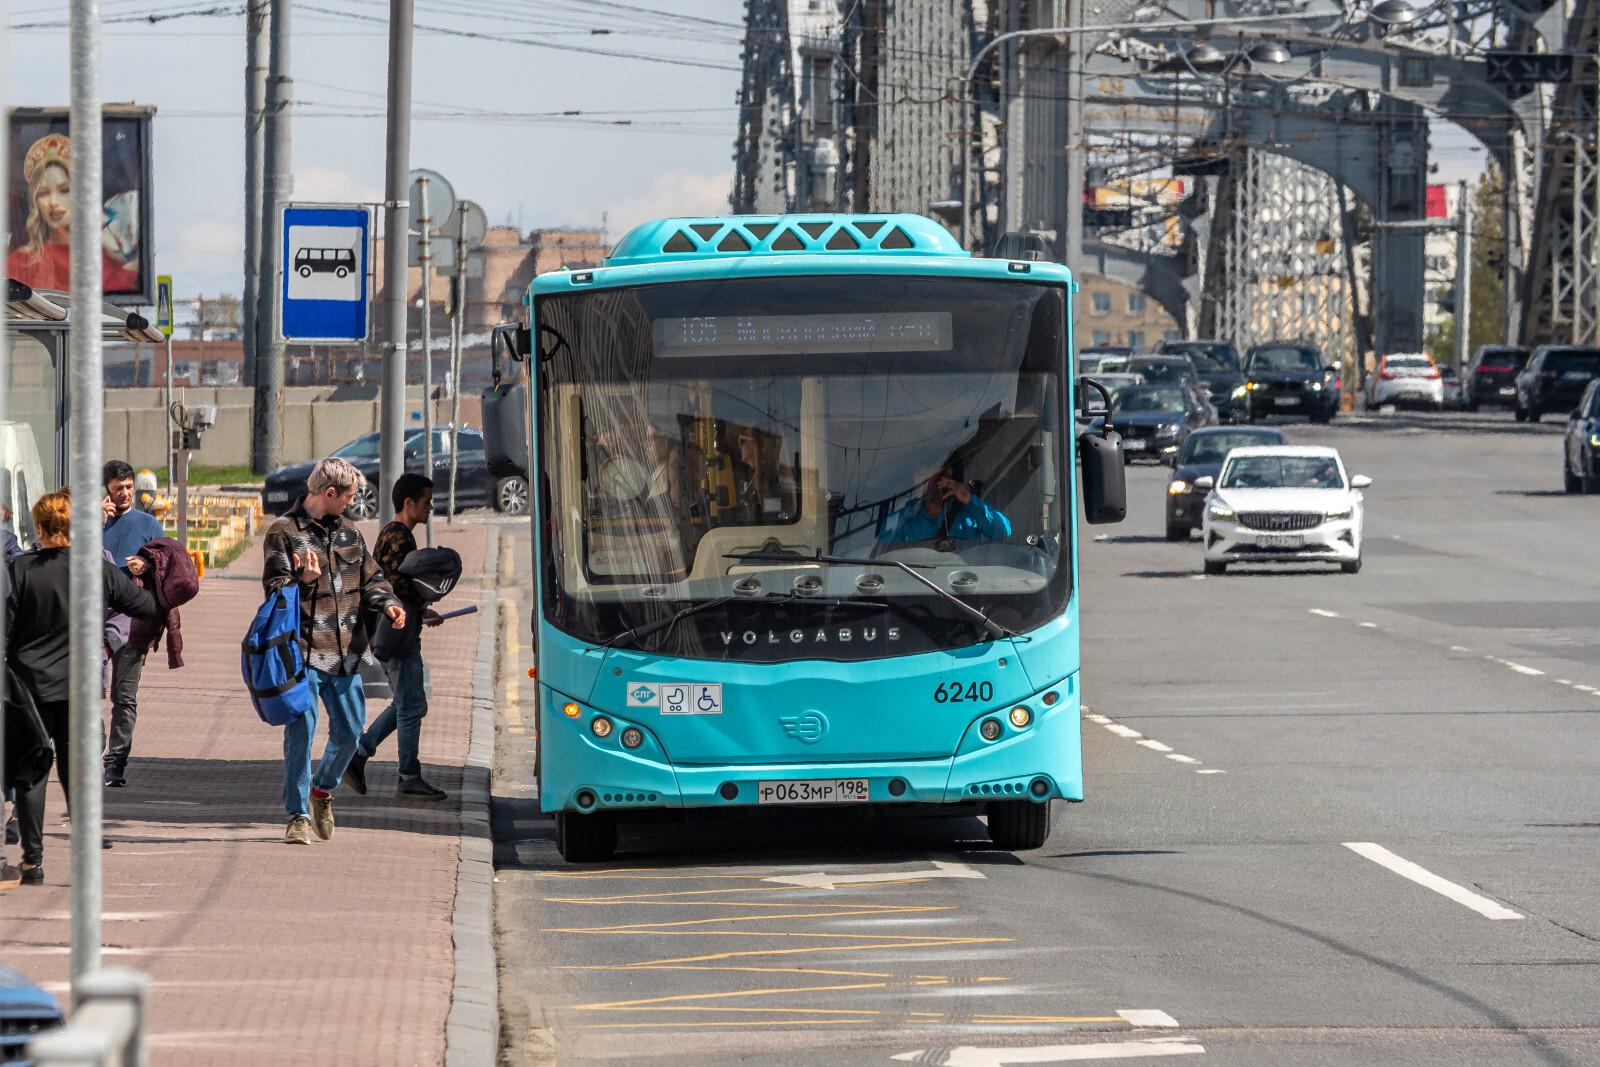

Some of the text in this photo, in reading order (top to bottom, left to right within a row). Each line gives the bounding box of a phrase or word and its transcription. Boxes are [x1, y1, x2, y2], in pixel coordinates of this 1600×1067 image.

[682, 316, 717, 342] 105
[720, 627, 901, 645] VOLGABUS
[934, 681, 993, 703] 6240
[837, 780, 864, 795] 198
